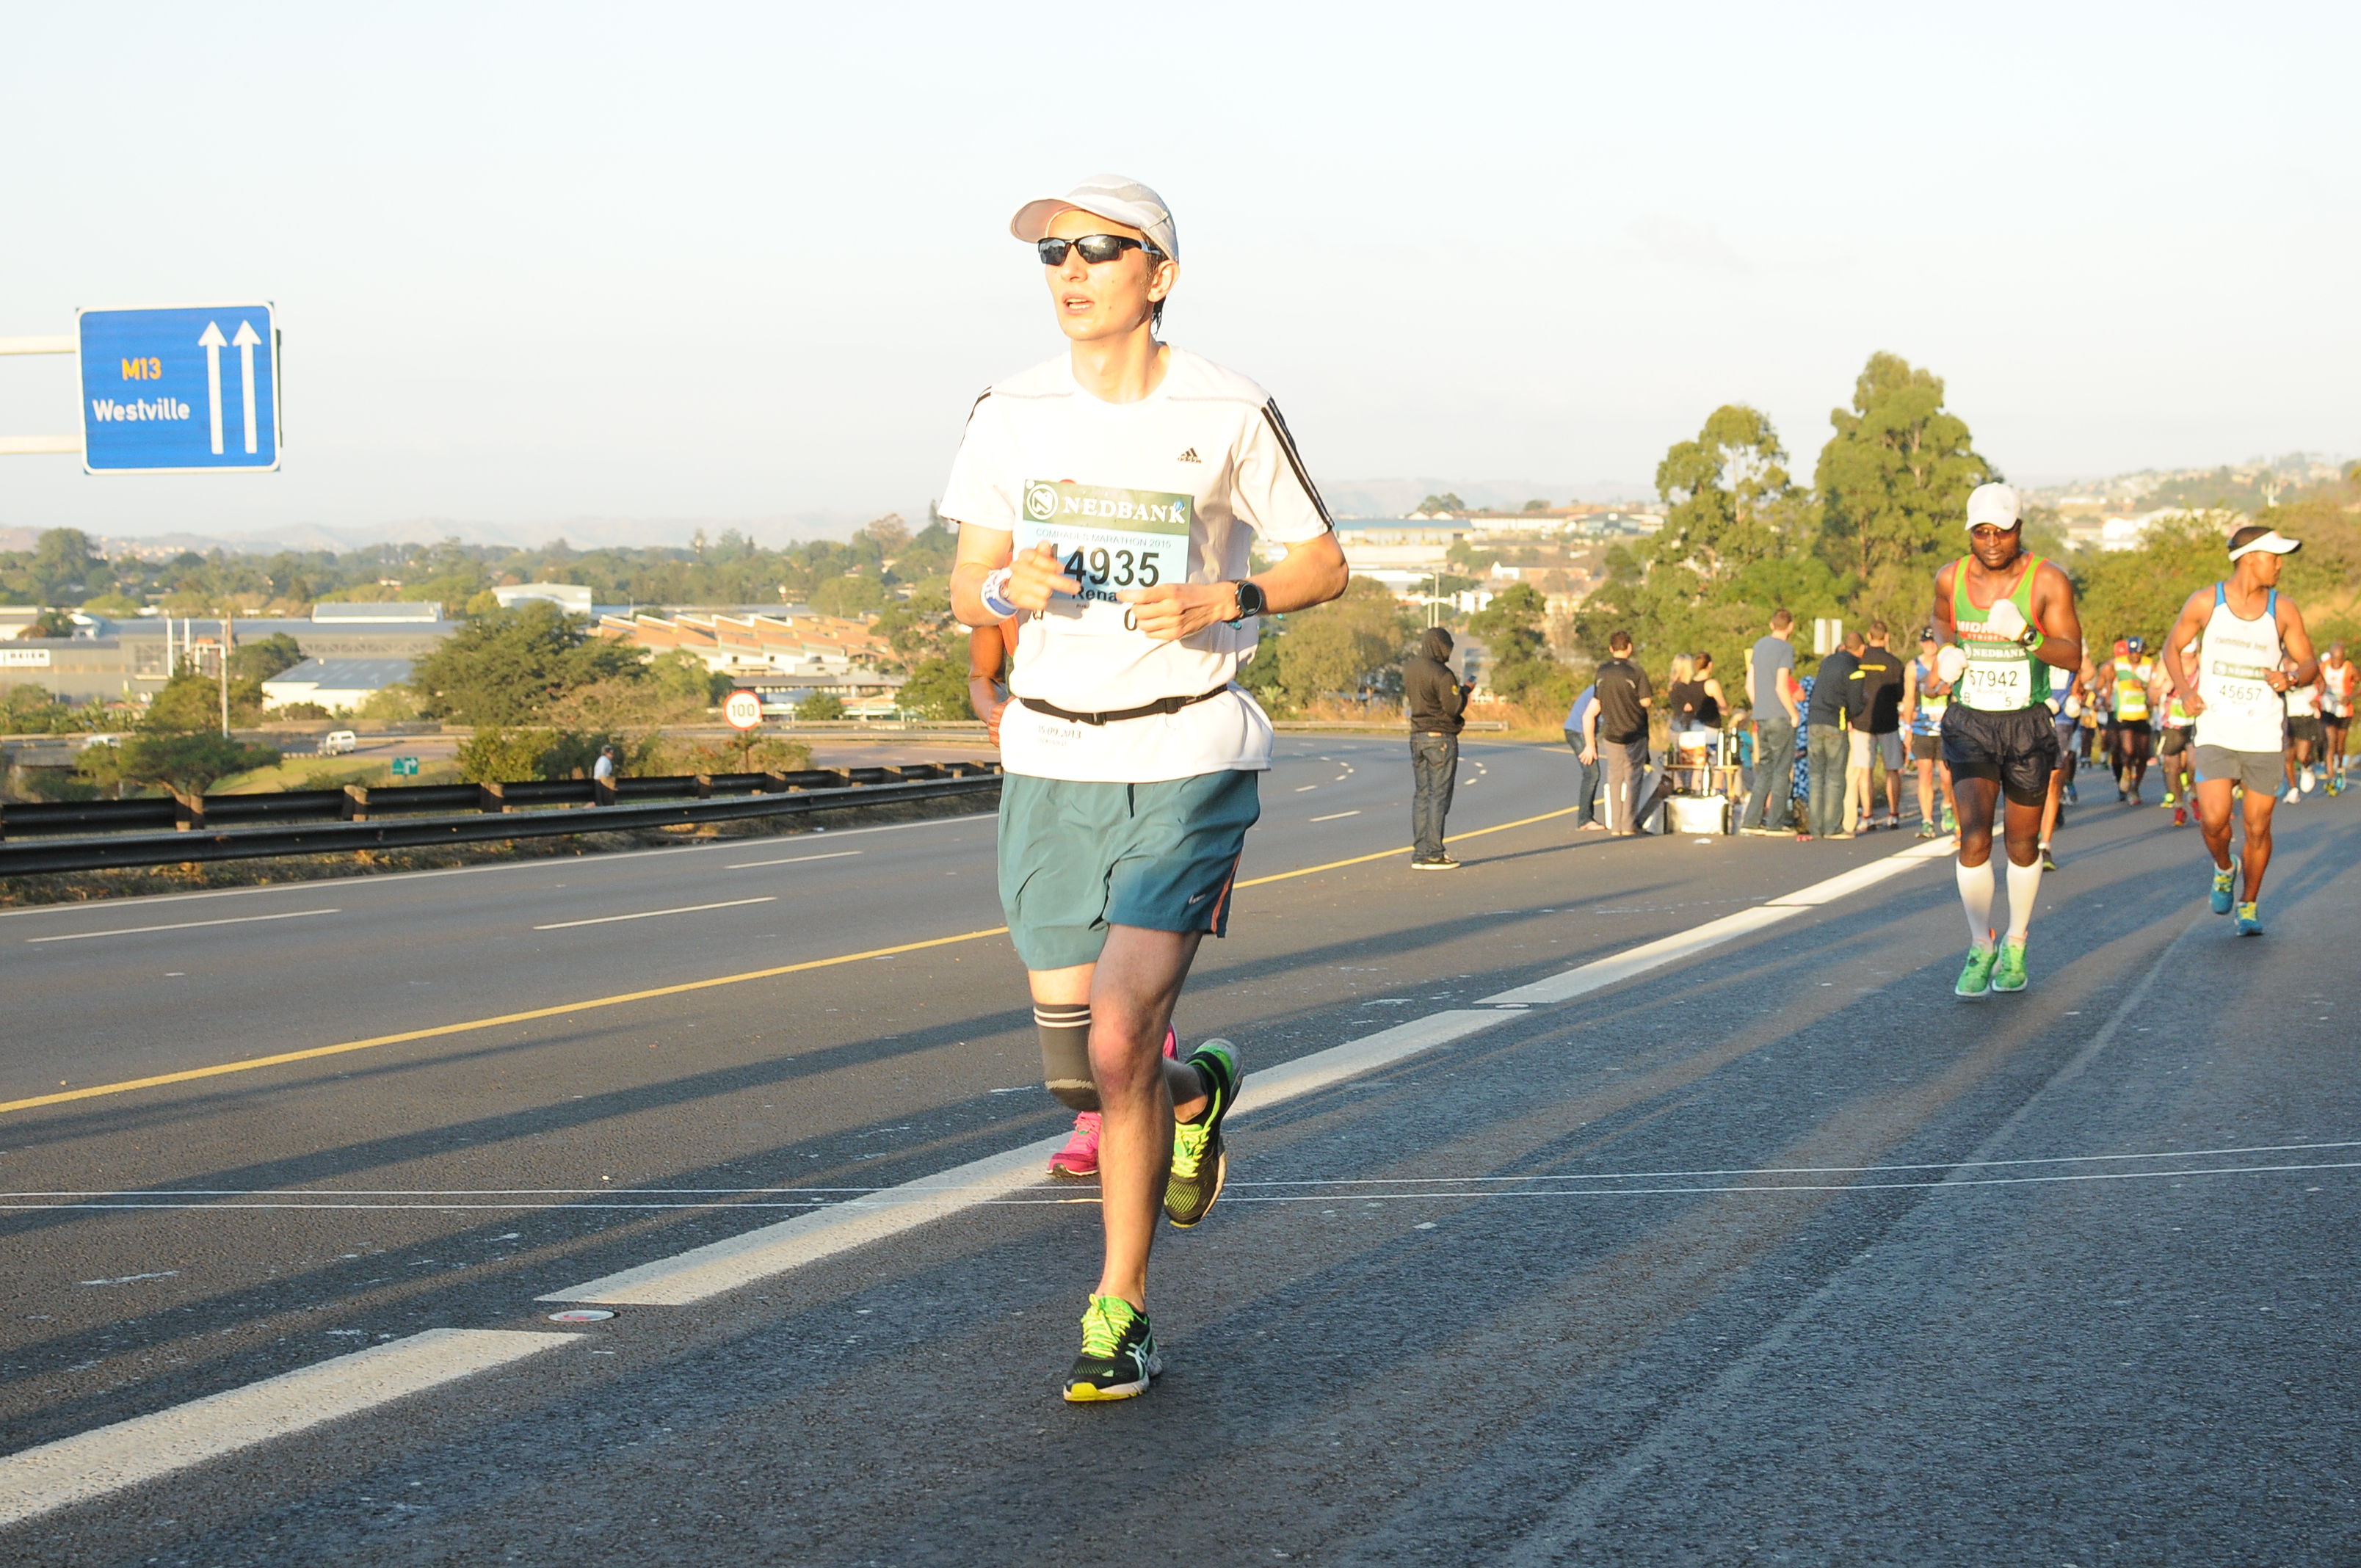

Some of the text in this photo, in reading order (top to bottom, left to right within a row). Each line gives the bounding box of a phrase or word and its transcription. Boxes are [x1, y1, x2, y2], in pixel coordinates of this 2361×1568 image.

[122, 357, 162, 381] M13
[93, 397, 190, 421] Westville
[1062, 496, 1186, 524] NEDBANK
[1036, 528, 1172, 549] COMRADES MARATHON 2015
[1072, 585, 1125, 602] Rena
[1956, 620, 1992, 634] MIDR
[1973, 648, 2026, 658] NEDBANK
[1969, 669, 2018, 687] 57942
[1964, 692, 1971, 703] B
[2219, 685, 2262, 700] 45657
[2005, 697, 2012, 707] 5
[731, 703, 755, 717] 100
[1038, 725, 1081, 738] 15.09.2013
